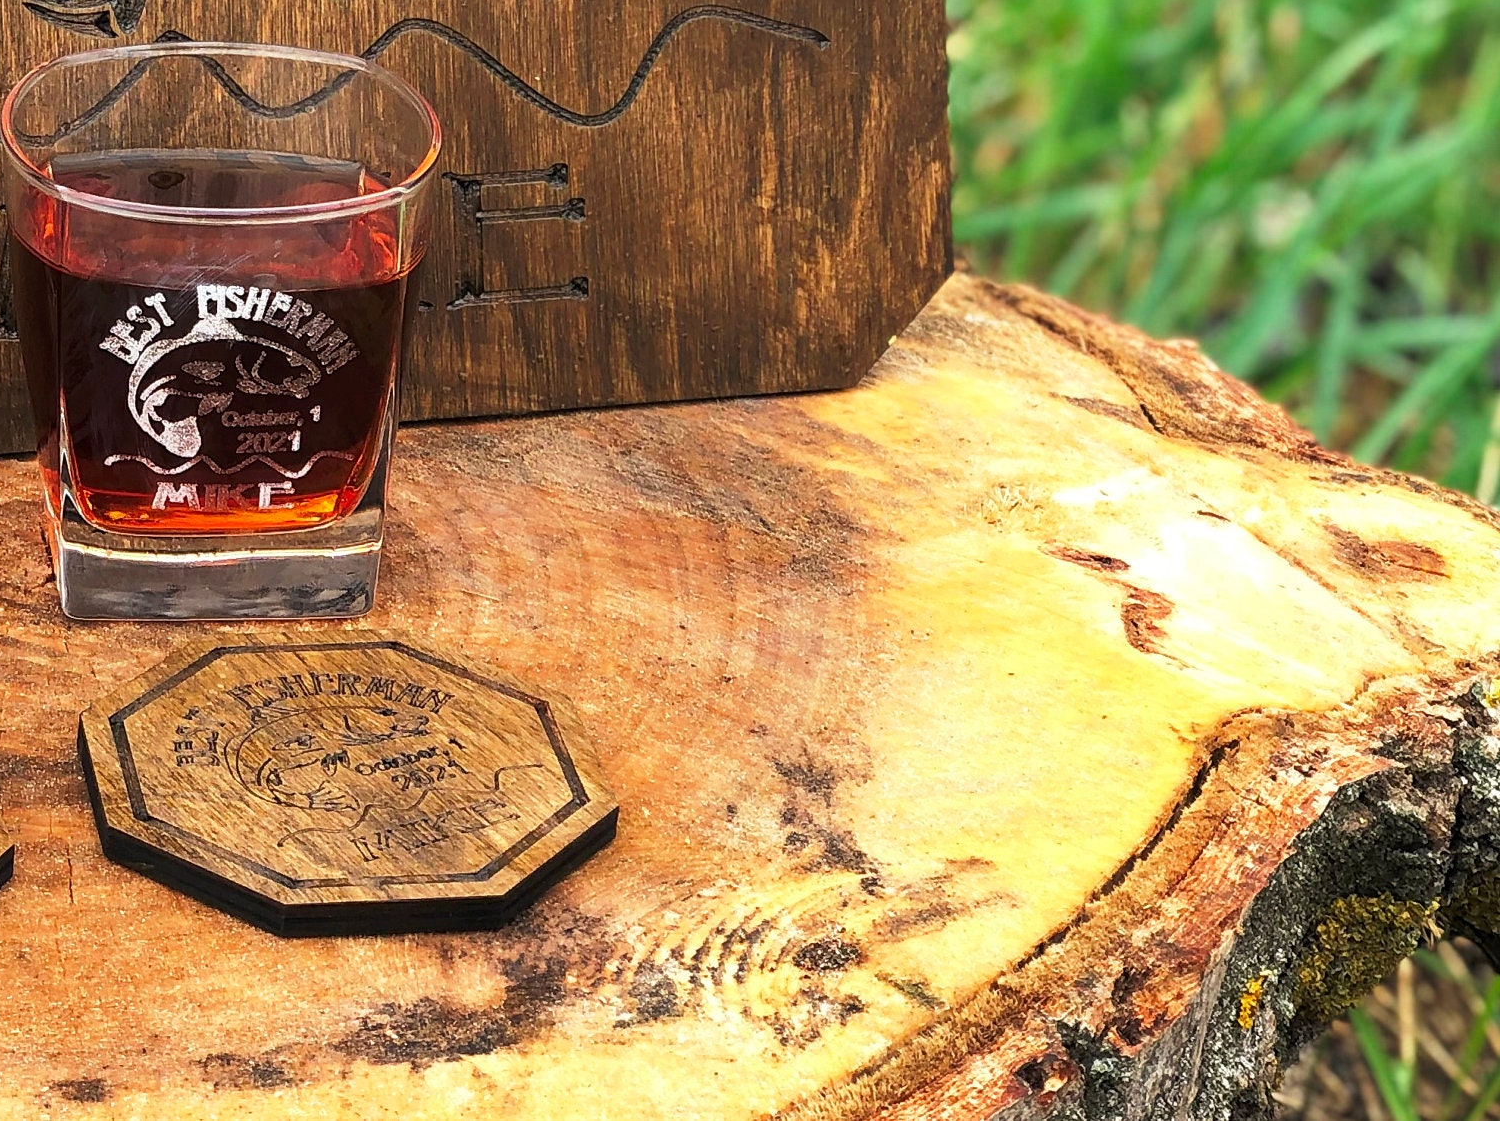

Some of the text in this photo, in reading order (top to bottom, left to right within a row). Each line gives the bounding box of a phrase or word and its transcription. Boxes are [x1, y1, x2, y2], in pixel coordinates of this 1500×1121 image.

[99, 284, 361, 375] BEST FISHERMAN
[309, 404, 321, 422] 1
[235, 430, 302, 454] 2021
[151, 480, 297, 511] MIKE
